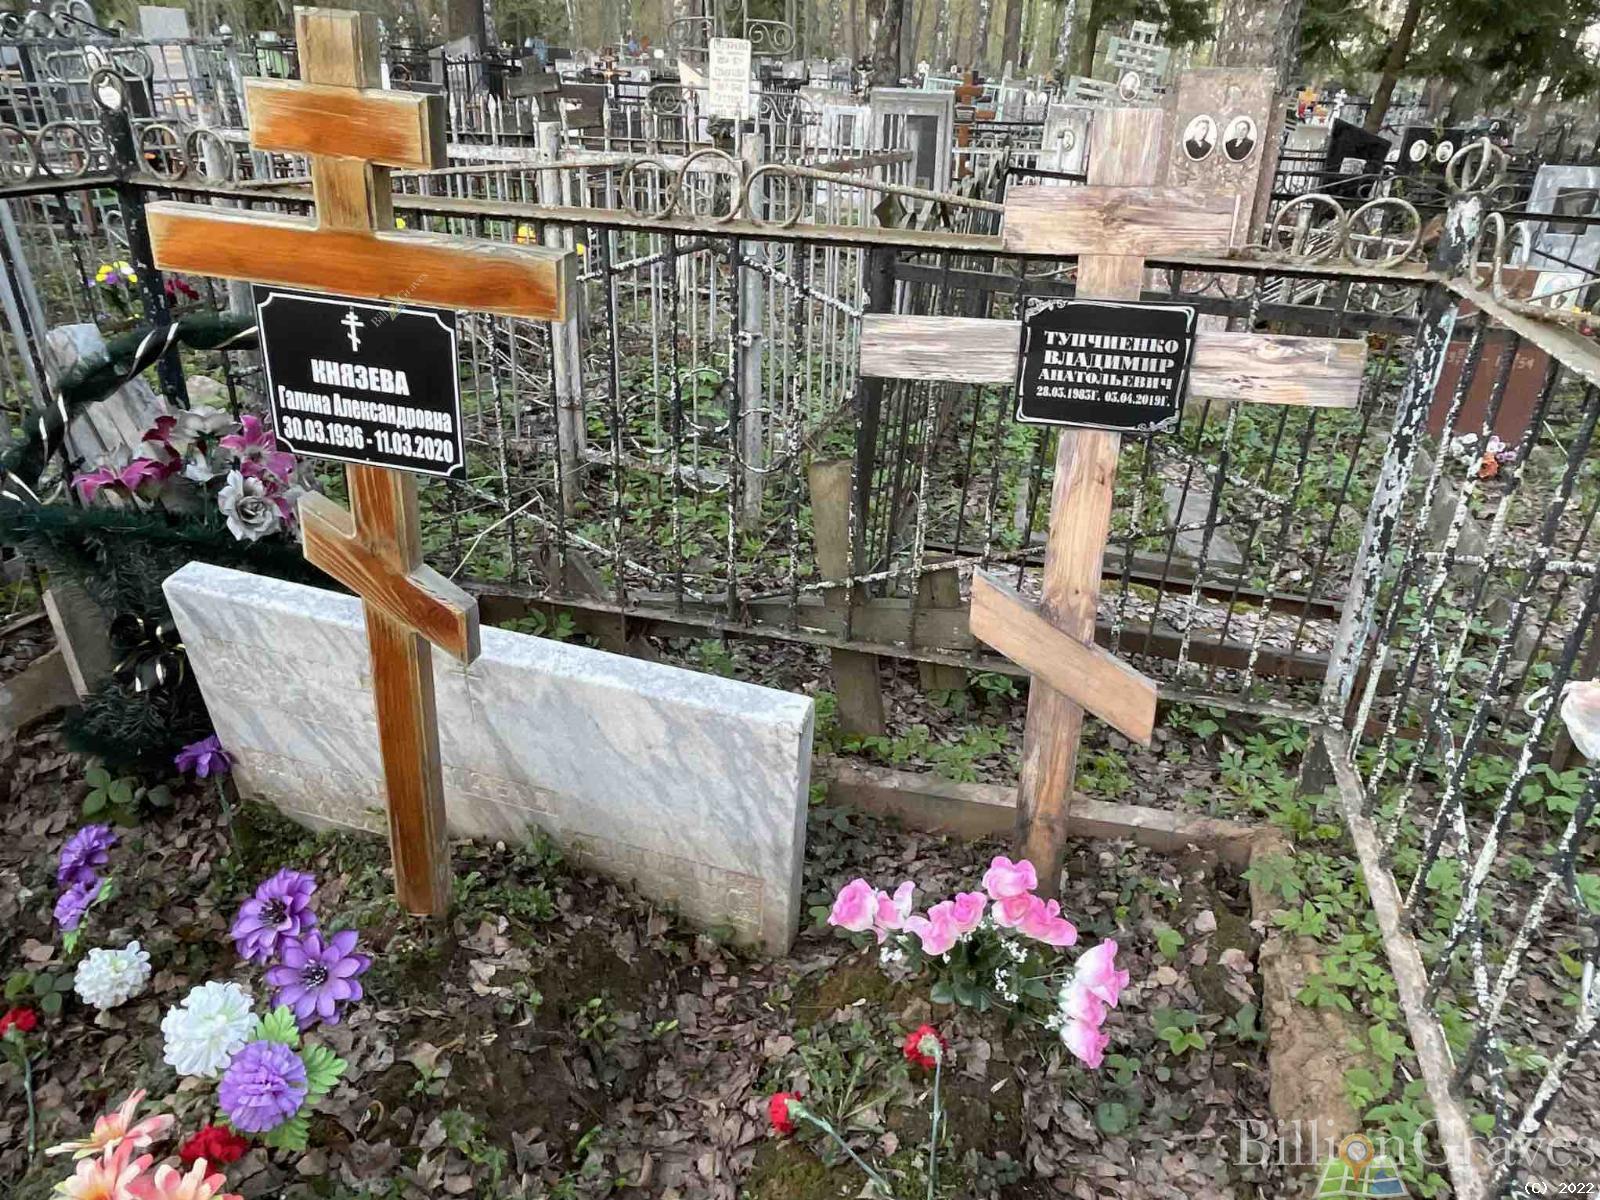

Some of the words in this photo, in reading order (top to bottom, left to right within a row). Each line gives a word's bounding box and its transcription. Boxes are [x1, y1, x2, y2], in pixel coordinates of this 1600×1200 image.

[1044, 330, 1179, 354] ТУПЧИЕНКО
[1044, 349, 1175, 373] ВЛАДИМИР
[310, 358, 410, 396] КНЯЗЕВА
[1038, 368, 1173, 390] АНАТОЛЬЕВИЧ
[278, 385, 331, 415] Галина
[333, 393, 453, 433] Александровна
[282, 415, 365, 449] 30.03.1936
[374, 429, 454, 463] 11.03.2020
